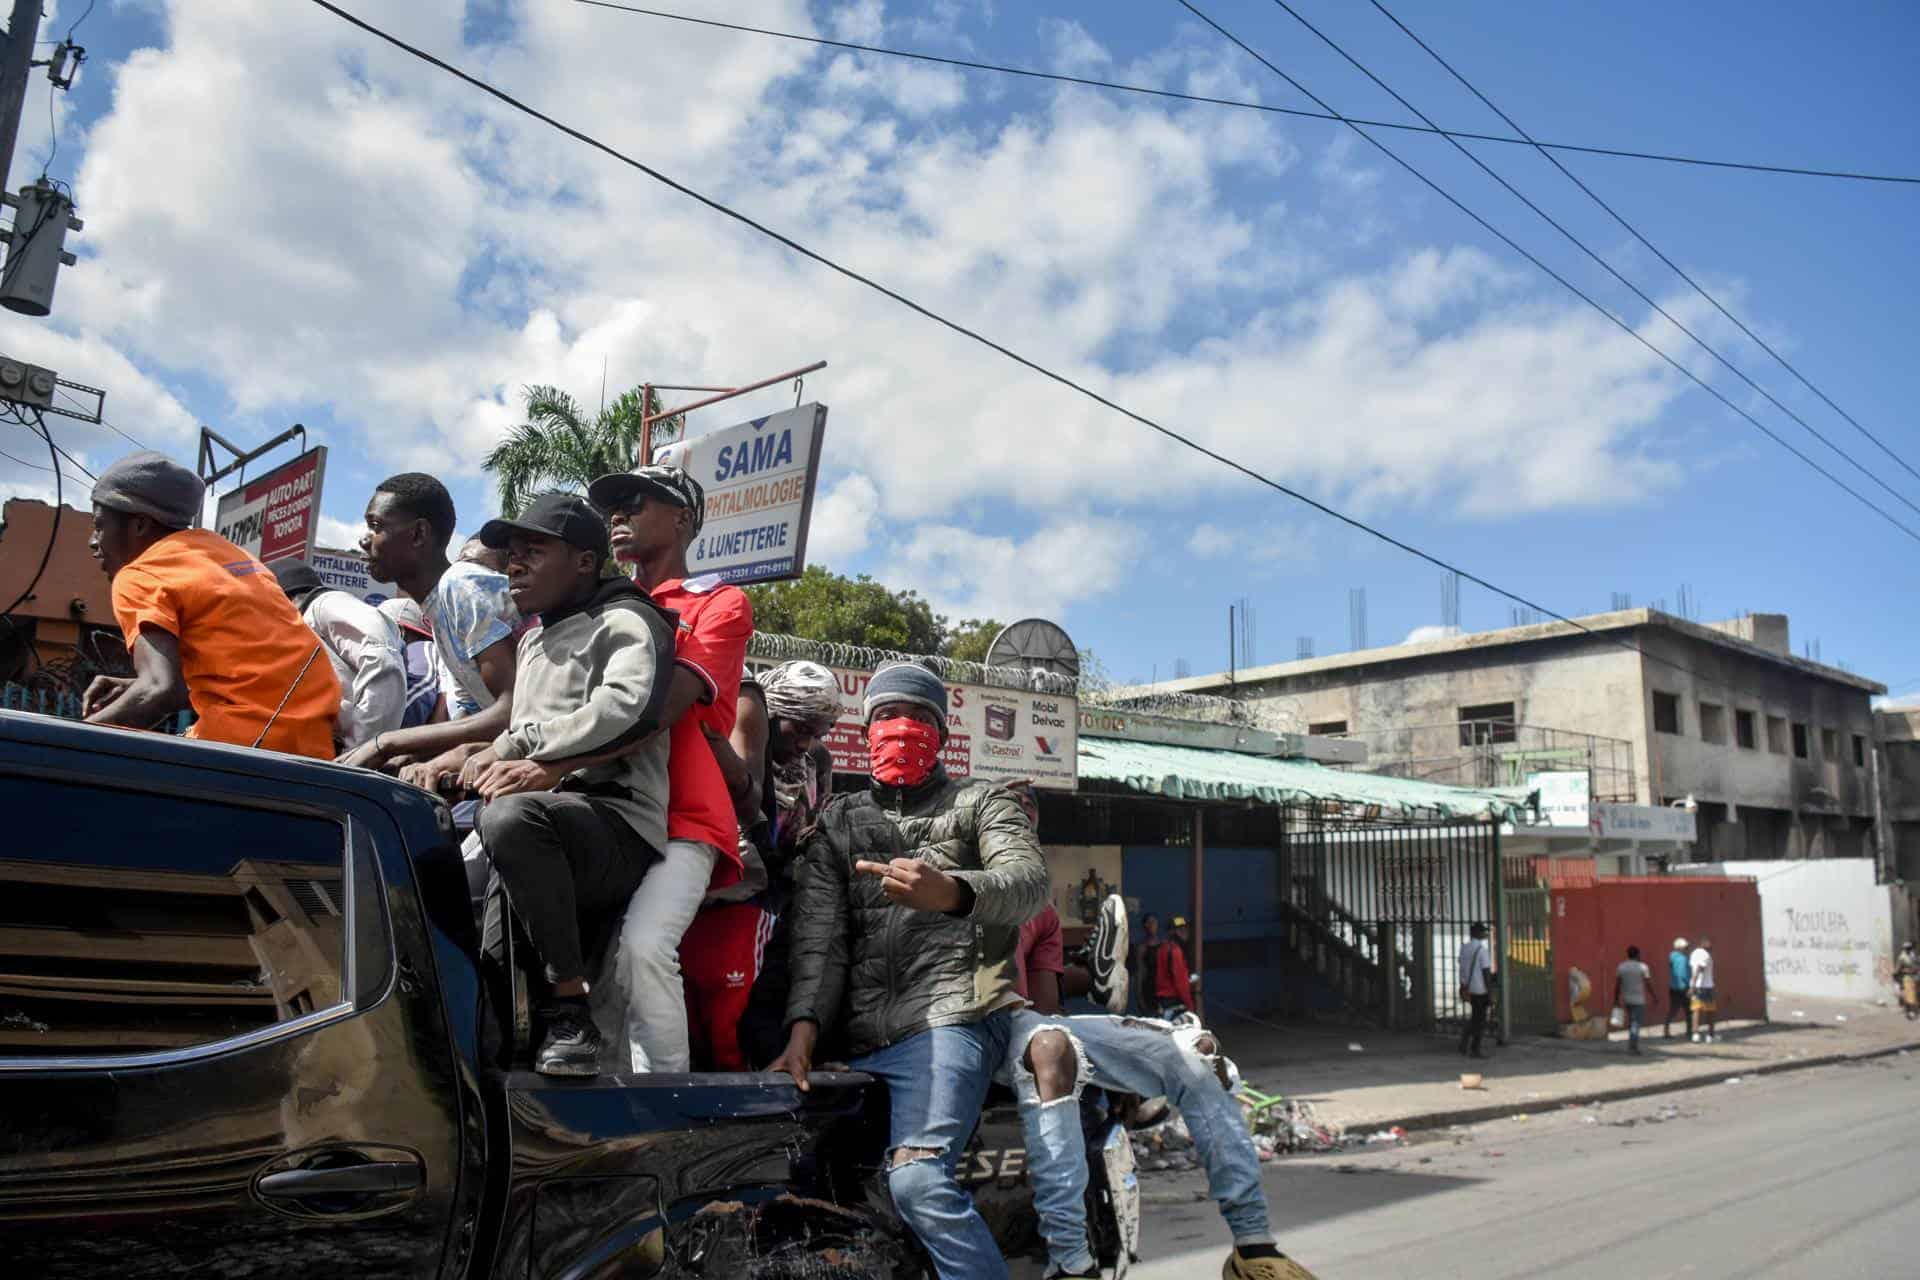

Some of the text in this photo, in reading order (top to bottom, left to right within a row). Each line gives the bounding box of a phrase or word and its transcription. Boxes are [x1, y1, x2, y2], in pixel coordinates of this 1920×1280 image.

[715, 429, 793, 481] SAMA
[268, 482, 292, 507] AUTO
[274, 514, 303, 539] TOYOTA
[696, 522, 788, 560] & LUNETTERIE
[1032, 700, 1059, 713] Mobil
[1032, 714, 1065, 728] Delvac
[833, 758, 848, 768] AM
